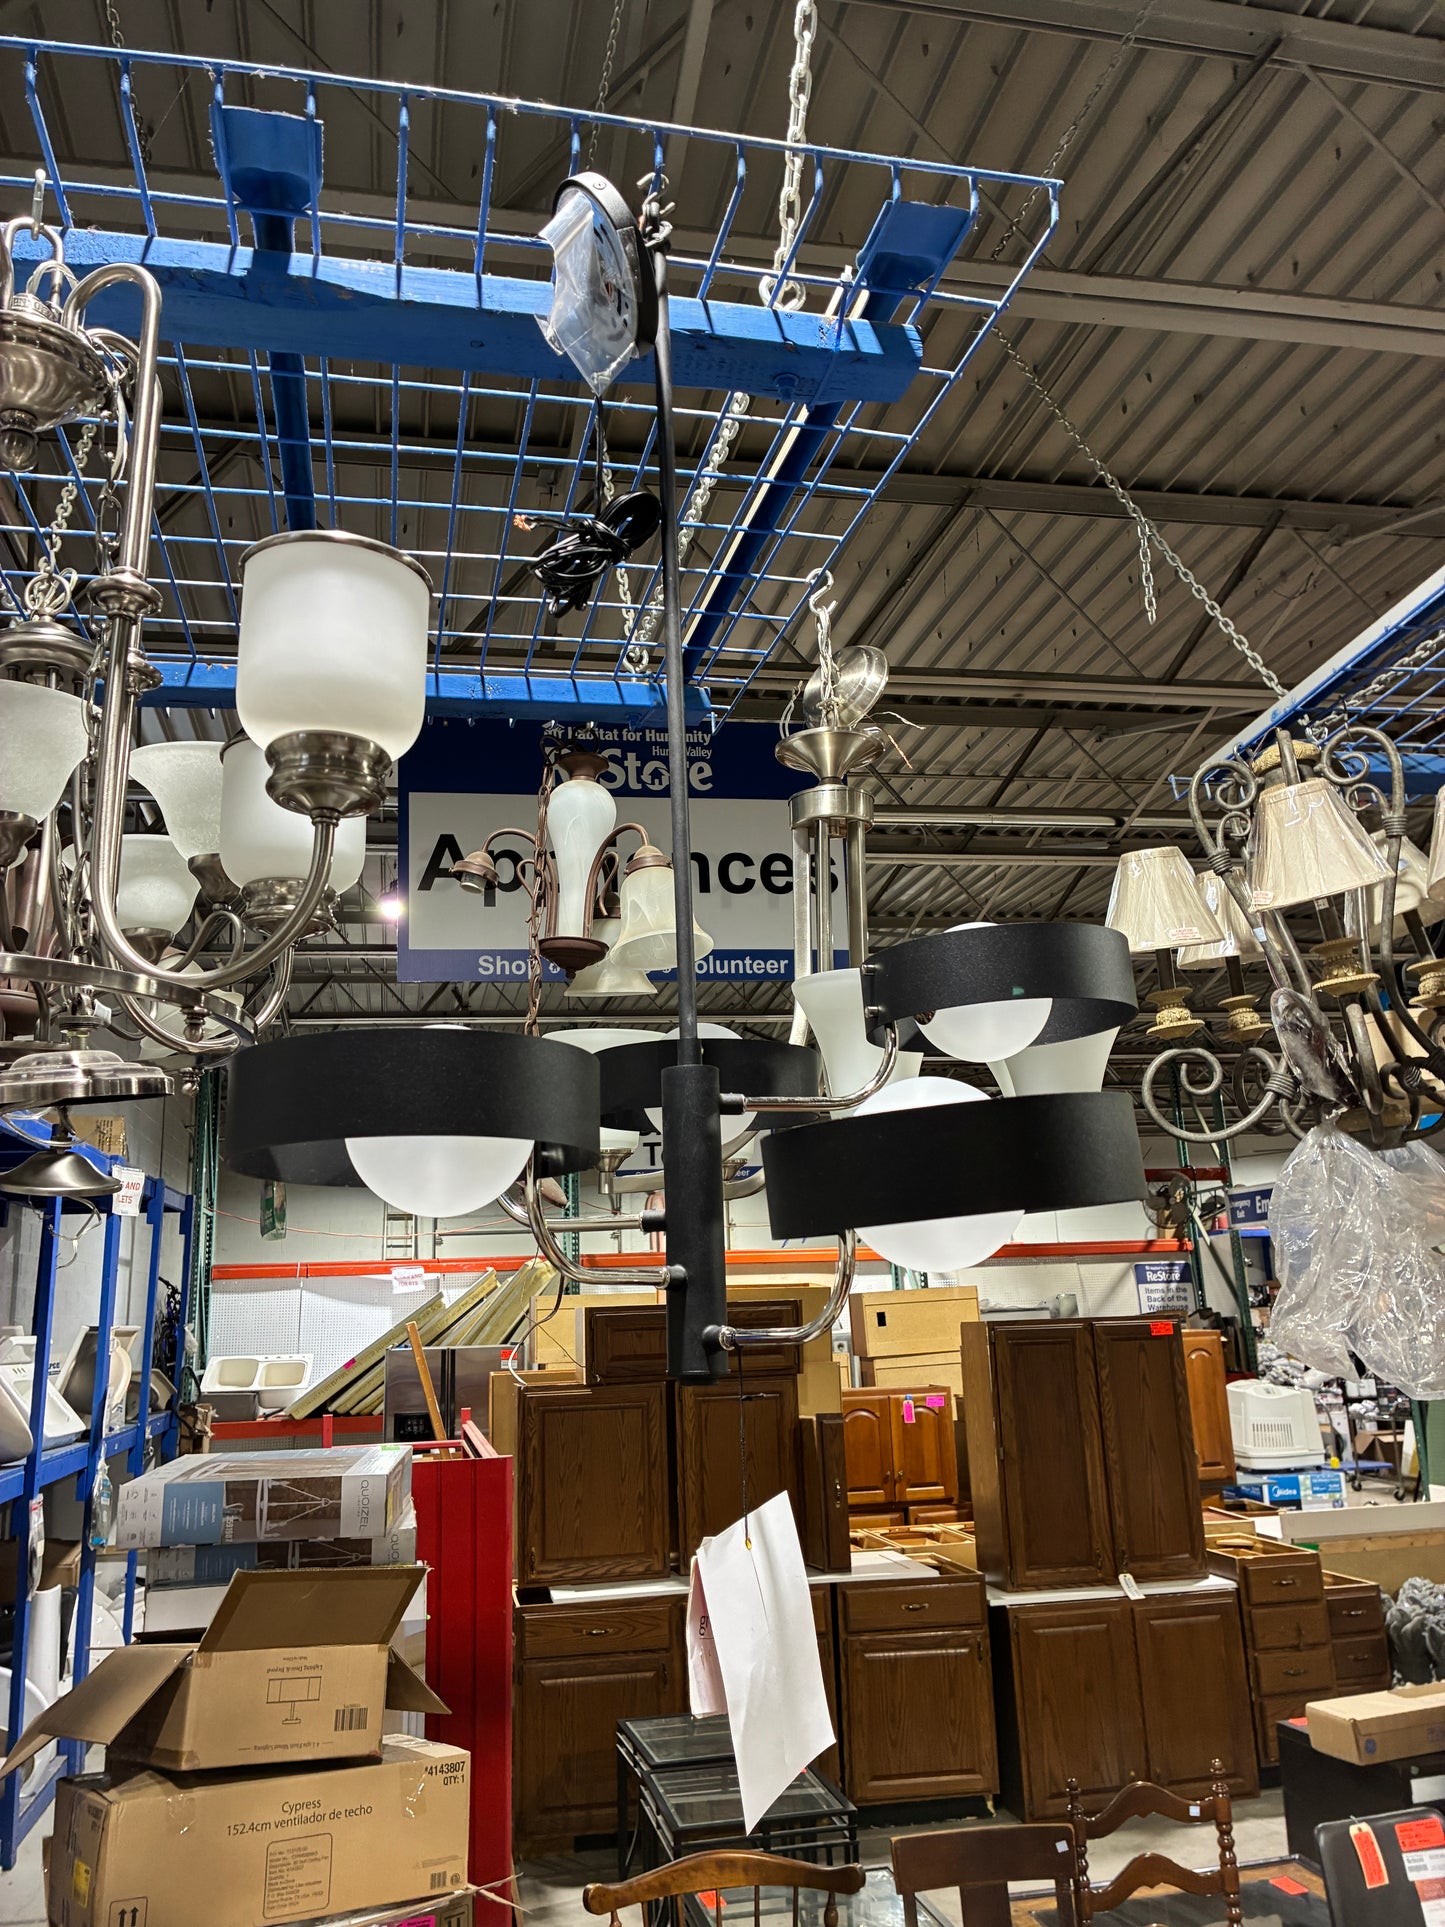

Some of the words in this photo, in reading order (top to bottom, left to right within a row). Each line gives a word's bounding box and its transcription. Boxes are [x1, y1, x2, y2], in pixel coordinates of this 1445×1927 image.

[622, 727, 643, 742] for
[695, 955, 789, 974] olunteer
[1146, 1271, 1181, 1282] ReStore
[1145, 1287, 1166, 1295] Items
[1167, 1286, 1174, 1294] in
[1147, 1295, 1166, 1303] Back
[1147, 1303, 1189, 1312] Warehouse
[1272, 1484, 1298, 1498] Midea
[360, 1479, 369, 1528] QUOIZEL
[442, 1775, 460, 1786] QTY:
[281, 1799, 322, 1814] Cypress
[226, 1818, 272, 1837] 152.4cm
[274, 1812, 327, 1829] ventilador
[329, 1808, 342, 1820] de
[344, 1804, 373, 1818] techo
